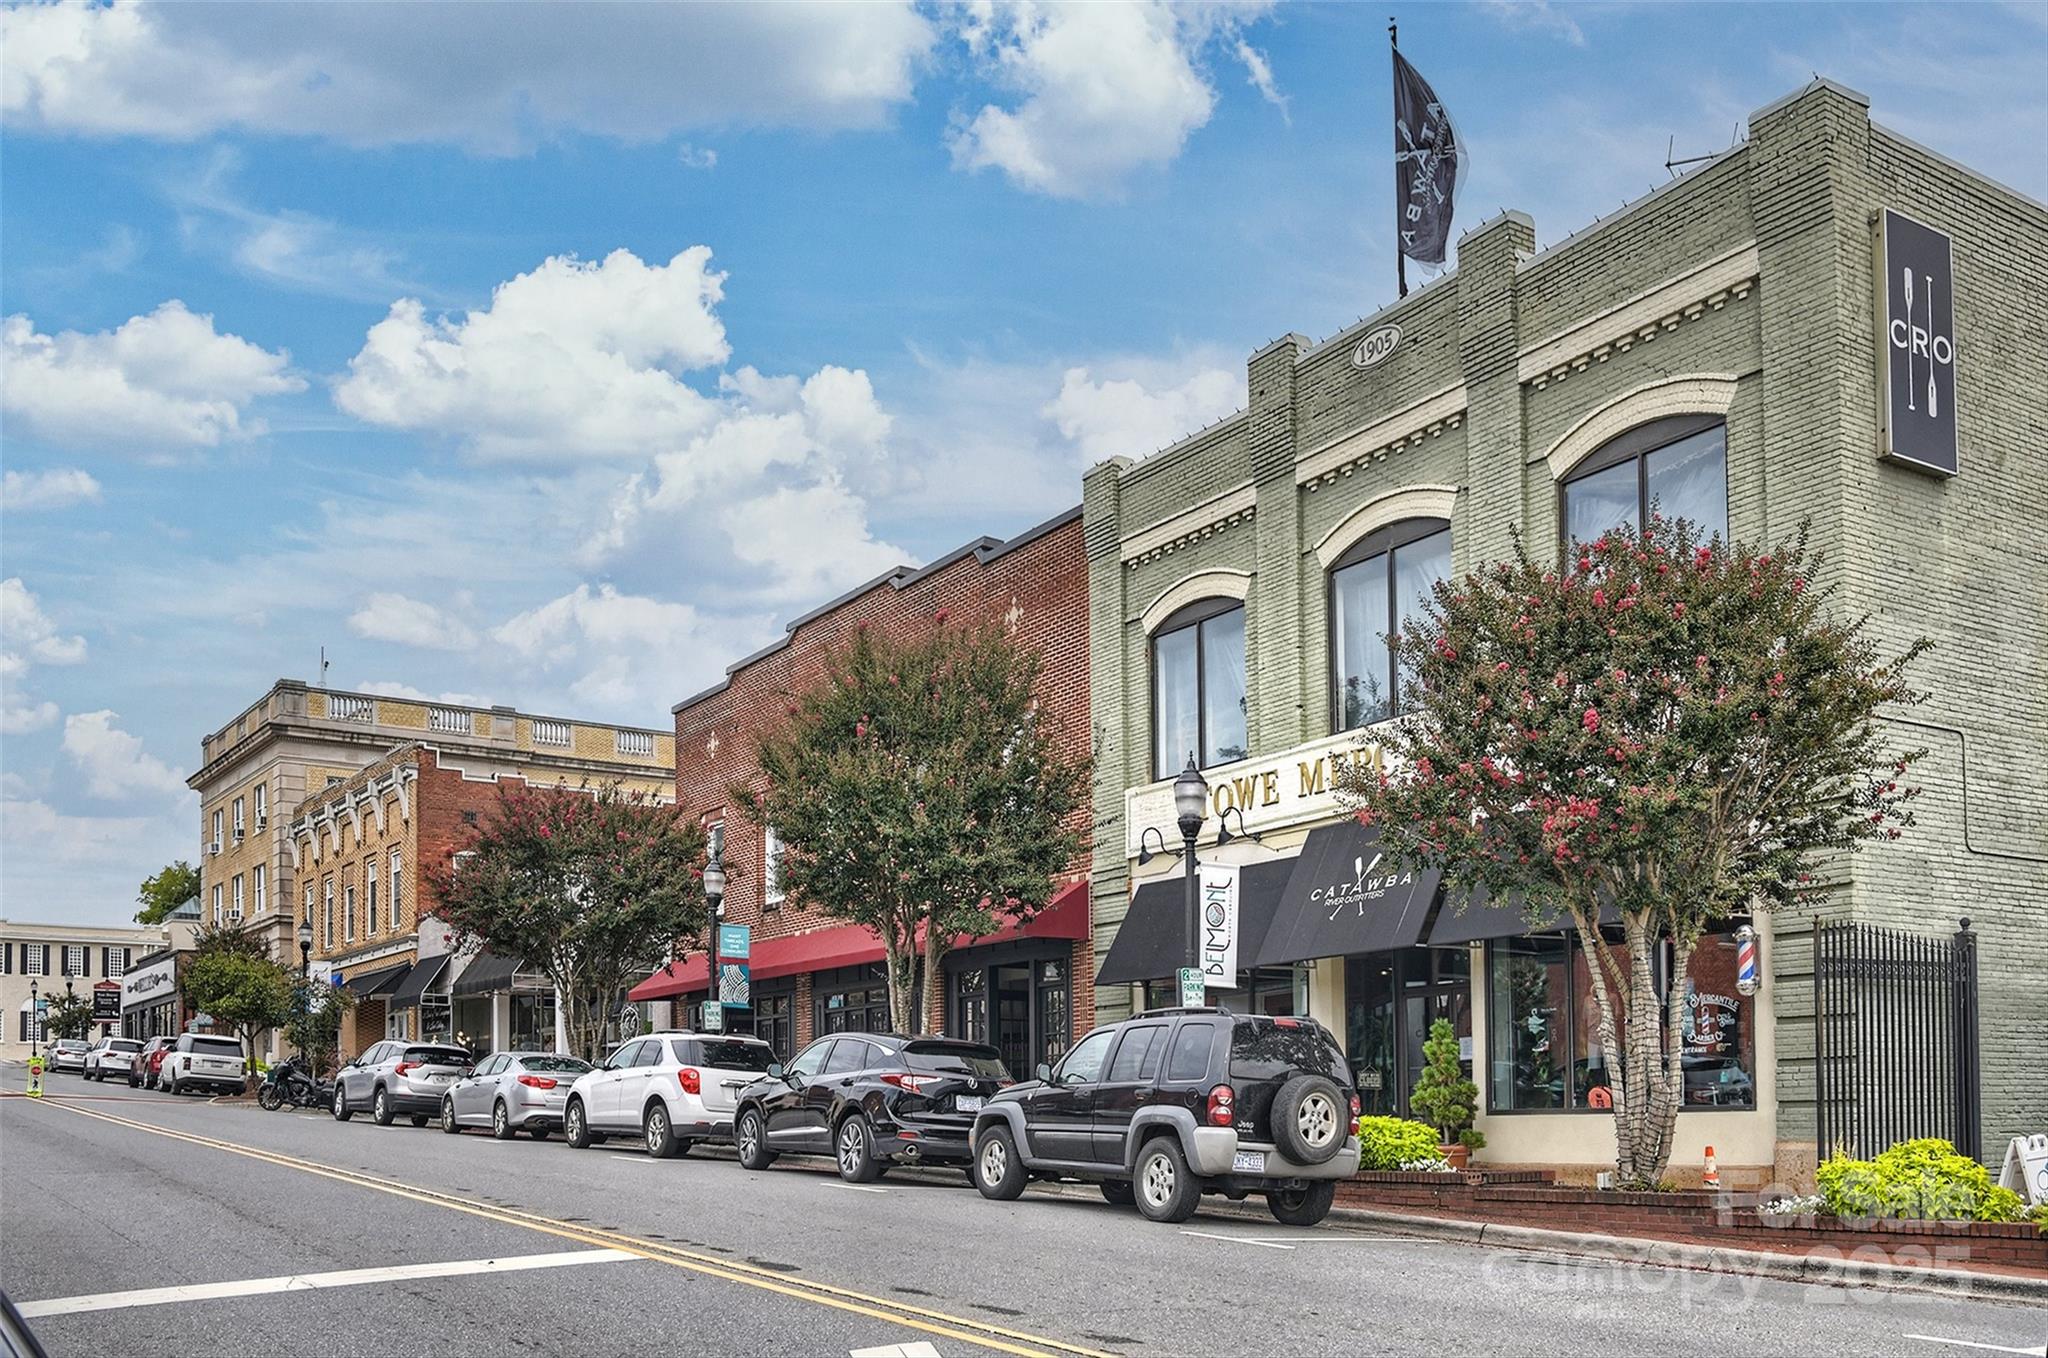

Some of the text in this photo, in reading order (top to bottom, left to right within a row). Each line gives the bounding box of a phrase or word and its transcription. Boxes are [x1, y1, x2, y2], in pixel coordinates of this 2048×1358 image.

[1360, 331, 1392, 363] 1905
[1891, 319, 1952, 364] CRO
[1310, 872, 1411, 901] CATAWBA
[1183, 970, 1189, 980] 2
[1184, 983, 1204, 992] PARKING
